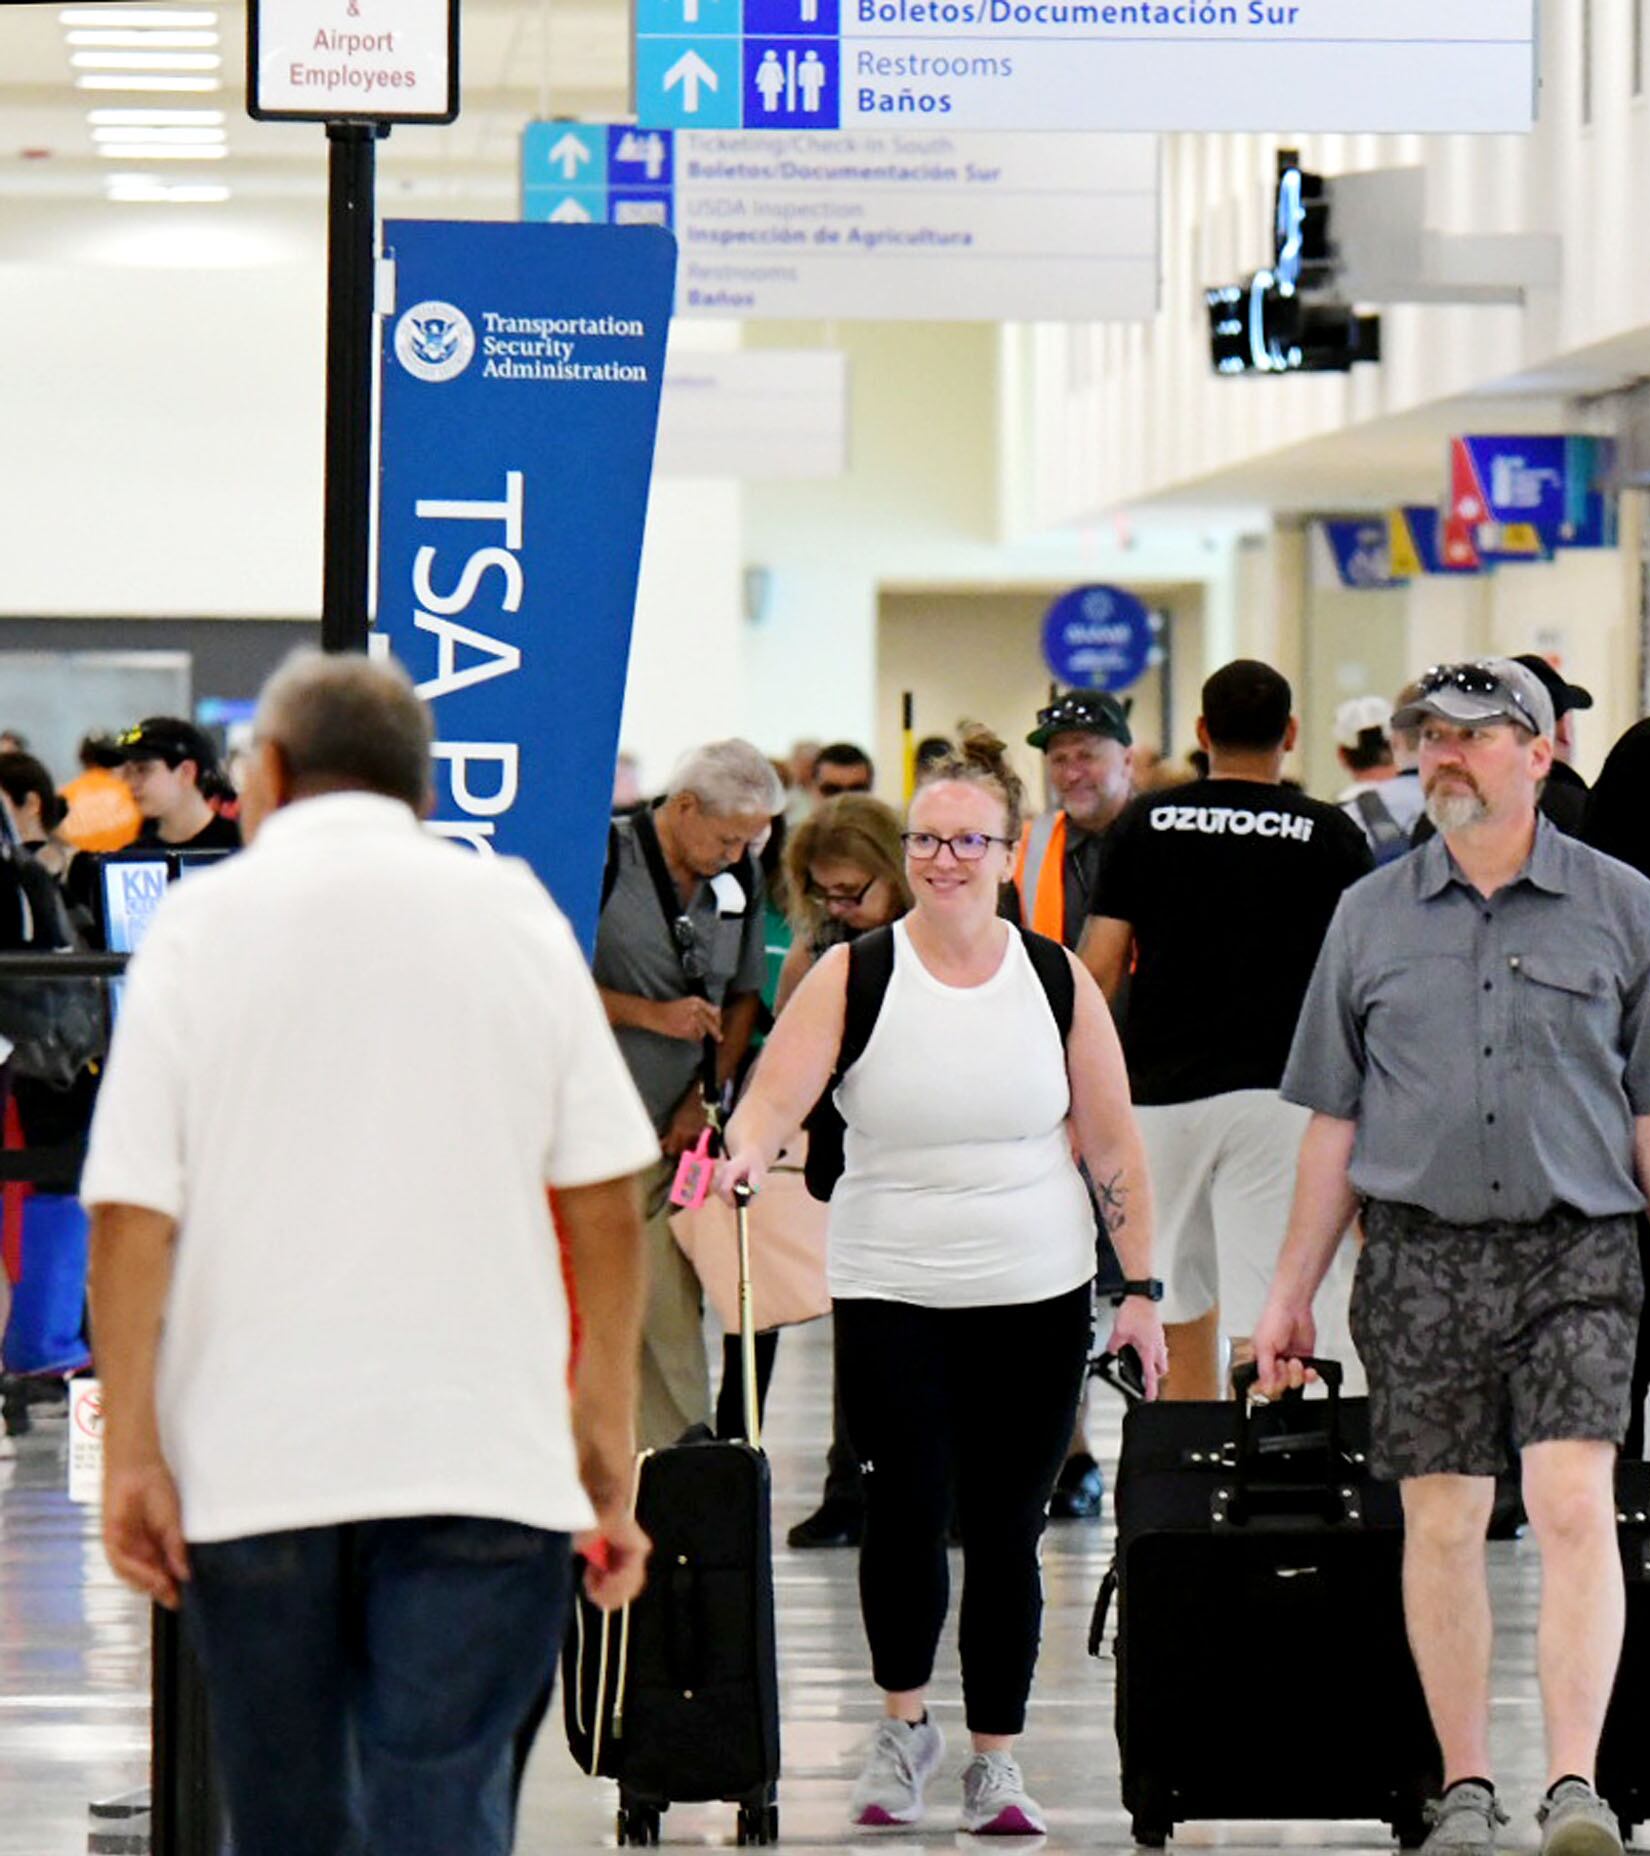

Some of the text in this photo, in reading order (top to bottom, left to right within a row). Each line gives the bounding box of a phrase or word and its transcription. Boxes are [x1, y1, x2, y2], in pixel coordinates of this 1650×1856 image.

[858, 0, 1299, 24] Boletos/Documentación Sur
[313, 29, 394, 55] Airport
[857, 50, 1013, 76] Restrooms
[289, 63, 416, 92] Employees
[858, 87, 952, 112] Baños
[965, 163, 1001, 181] Sur
[813, 226, 840, 244] de
[847, 227, 974, 249] Agricultura
[482, 312, 645, 338] Transportation
[483, 336, 575, 362] Security
[483, 357, 648, 382] Administration
[412, 470, 524, 701] TSA
